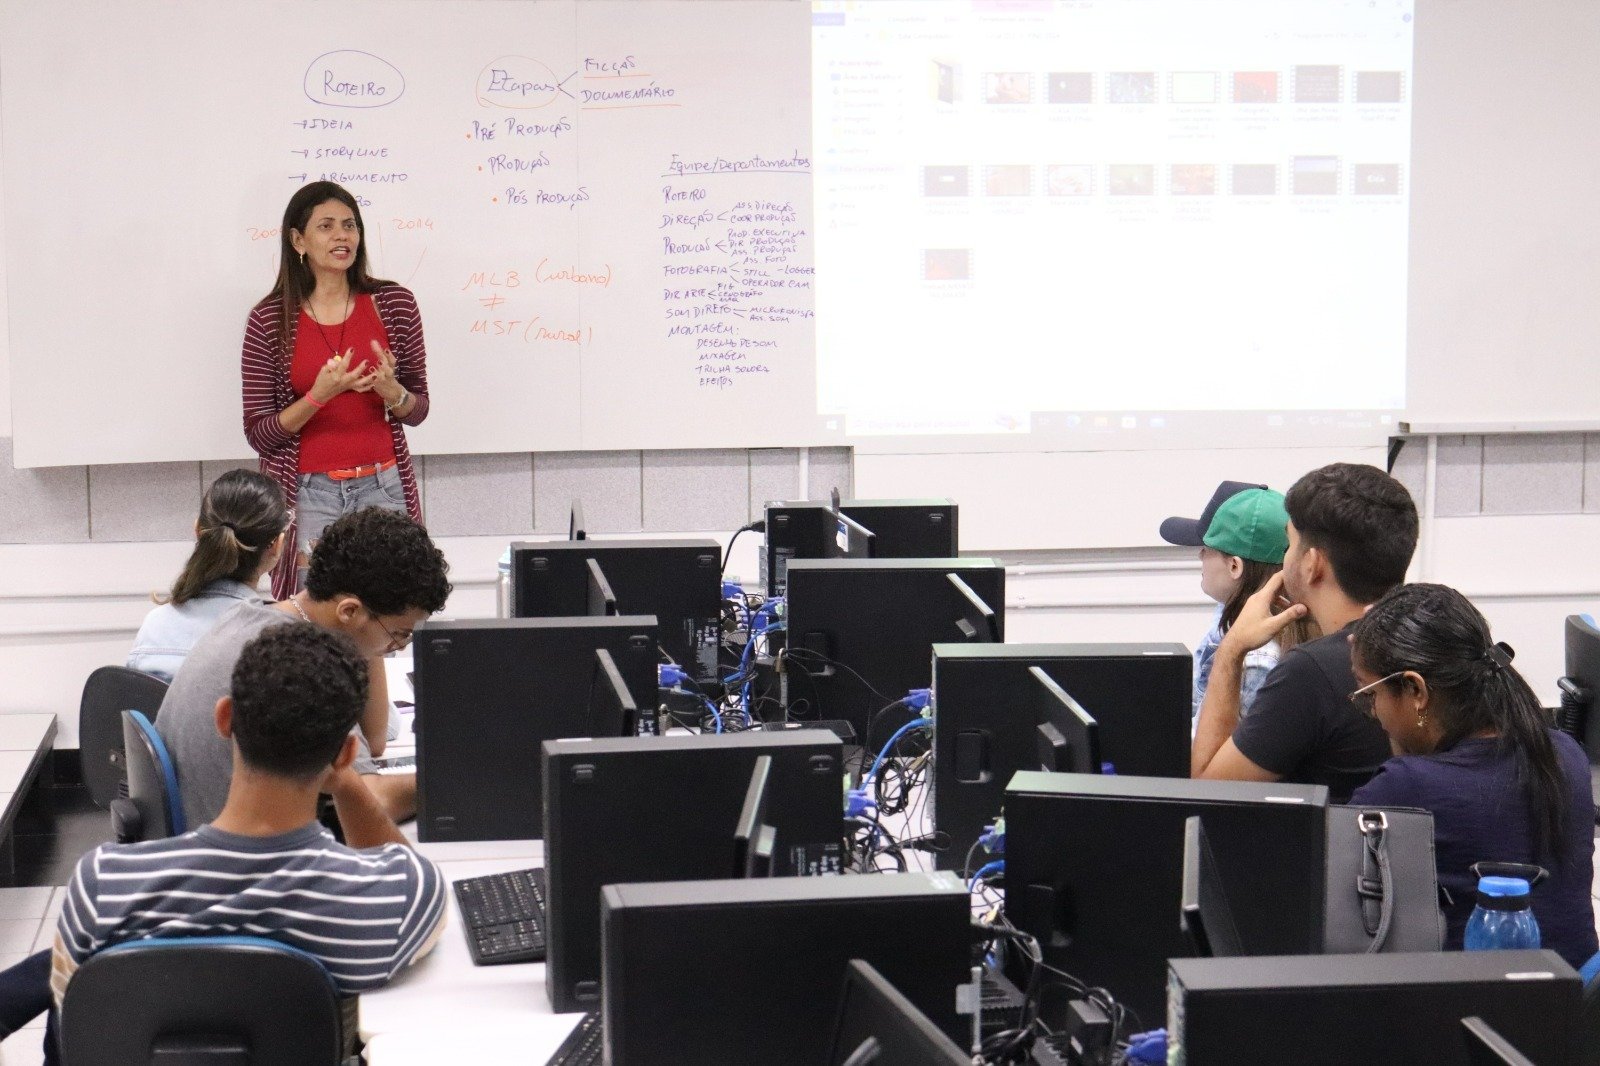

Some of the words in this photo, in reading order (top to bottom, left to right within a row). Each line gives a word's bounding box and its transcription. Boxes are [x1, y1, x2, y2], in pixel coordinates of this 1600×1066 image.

[487, 68, 557, 97] Etapas
[309, 118, 353, 130] IDEIA
[315, 146, 389, 160] STORYLINE
[319, 172, 408, 183] ARGUMENTO
[662, 186, 706, 204] ROTEIRO
[663, 265, 728, 277] FOTOGRAFIA
[462, 270, 520, 290] MLB
[470, 319, 523, 336] MST
